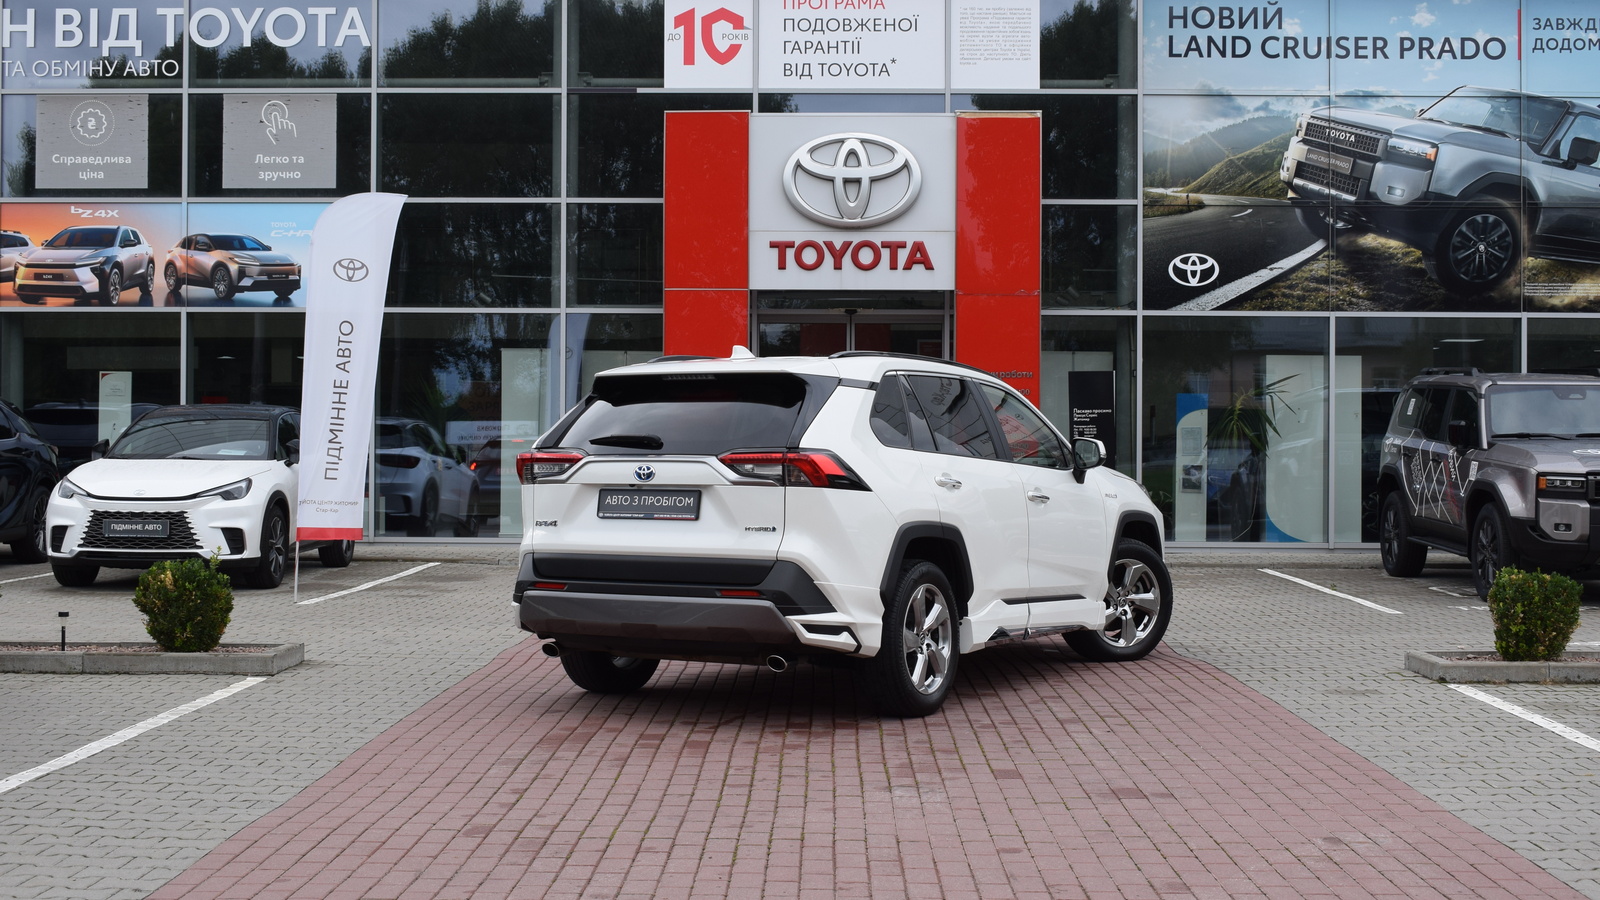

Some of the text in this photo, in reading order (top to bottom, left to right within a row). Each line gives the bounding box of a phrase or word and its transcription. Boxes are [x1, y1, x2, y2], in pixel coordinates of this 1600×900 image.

[783, 0, 886, 9] ПРОГРАМА
[1168, 1, 1283, 30] НОВИЙ
[3, 7, 372, 56] Н ВІД TOYOTA
[783, 15, 918, 35] ПОДОВЖЕНОЇ
[1532, 17, 1600, 33] ЗАВЖД
[667, 33, 749, 42] ДО РОКІВ
[783, 37, 861, 54] ГАРАНТІЇ
[1168, 35, 1506, 60] LAND CRUISER PRADO
[1532, 38, 1600, 54] ДОДОМ
[2, 60, 179, 77] ТА ОБМІНУ АВТО
[783, 63, 813, 80] ВІД
[1325, 128, 1355, 142] TOYOTA
[52, 154, 132, 166] Справедлива
[254, 154, 305, 166] Легко та
[1307, 152, 1318, 161] LAND
[78, 168, 104, 181] ціна
[258, 170, 301, 182] зручно
[70, 206, 119, 218] bZ4X
[769, 240, 935, 271] TOYOTA
[1000, 370, 1033, 380] роботи
[324, 320, 354, 480] ПІДМІННЕ АВТО
[605, 495, 630, 505] АВТО
[641, 496, 694, 507] ПРОБІГОМ
[111, 523, 143, 531] ПІДМІННЕ
